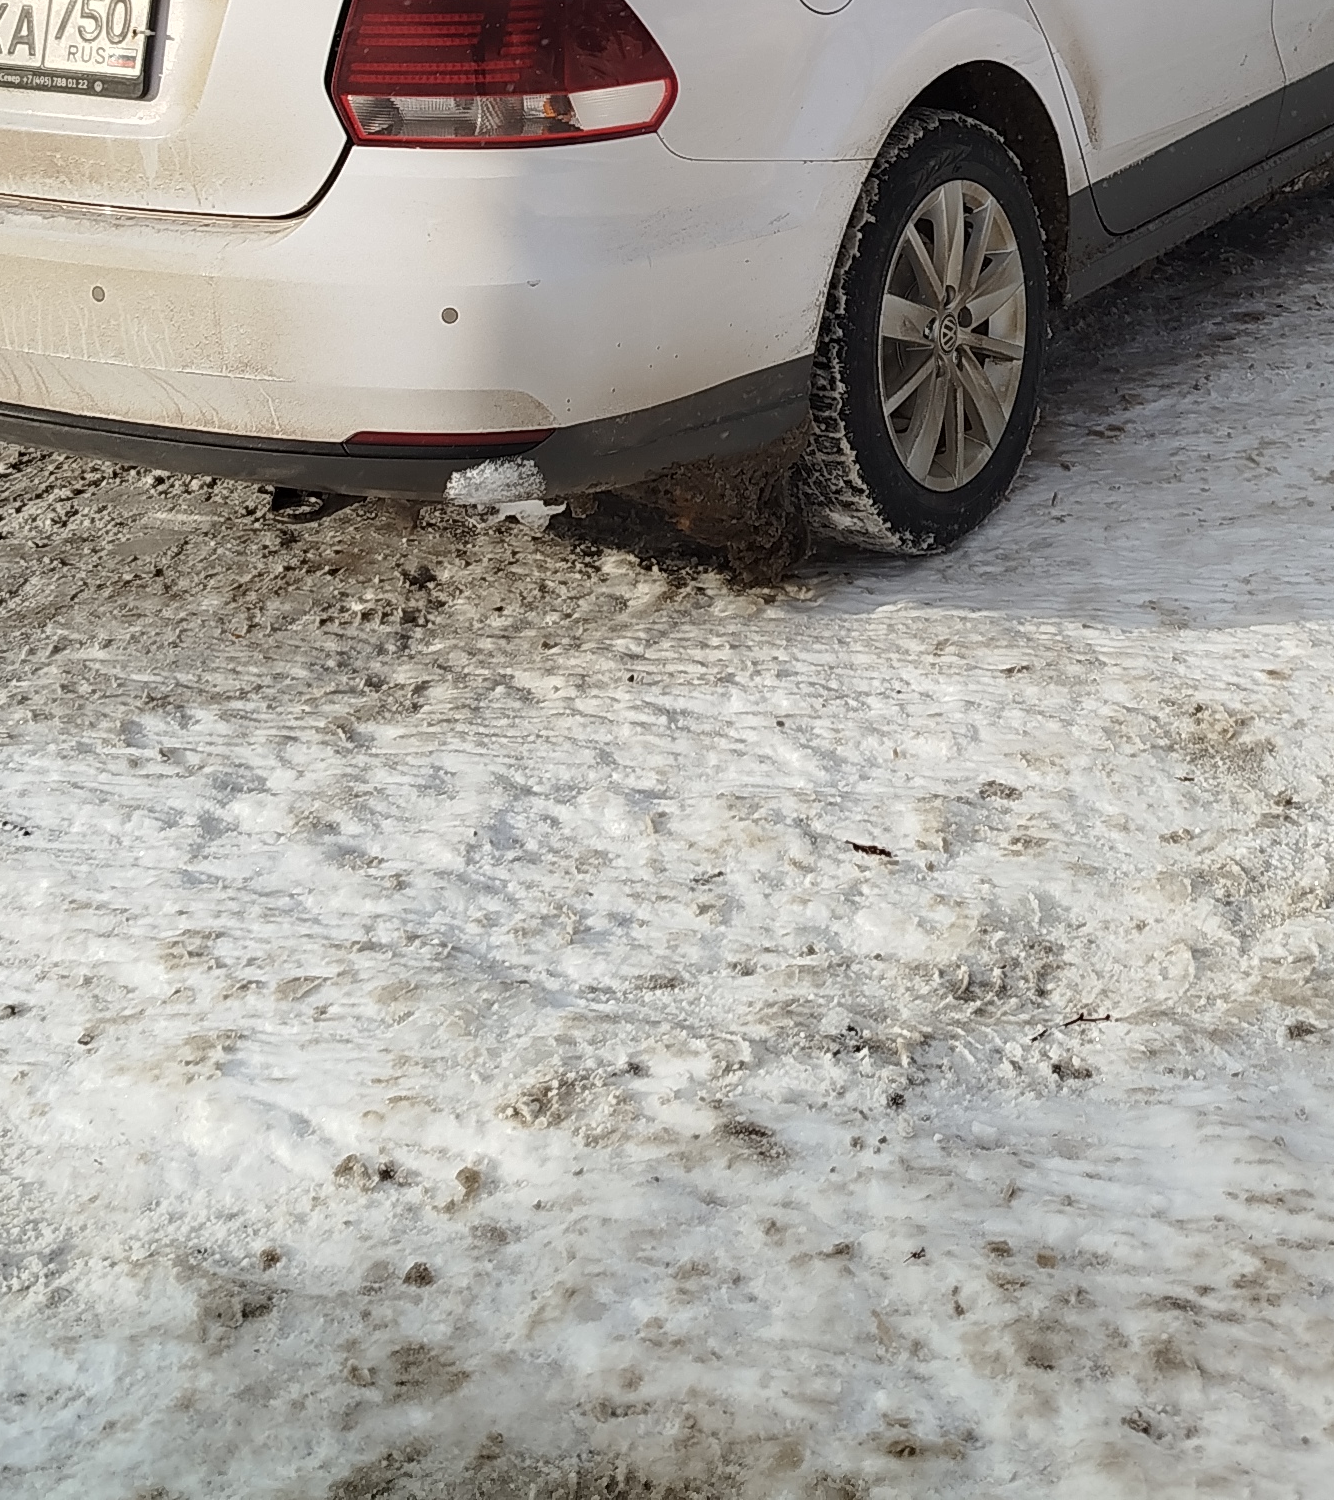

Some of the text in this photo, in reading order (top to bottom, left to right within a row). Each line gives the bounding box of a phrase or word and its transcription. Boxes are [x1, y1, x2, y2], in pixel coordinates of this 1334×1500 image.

[67, 45, 106, 64] RUS
[0, 73, 20, 84] Север
[22, 75, 32, 84] +7
[33, 76, 51, 87] (495)
[68, 79, 77, 88] 01
[78, 80, 88, 89] 22
